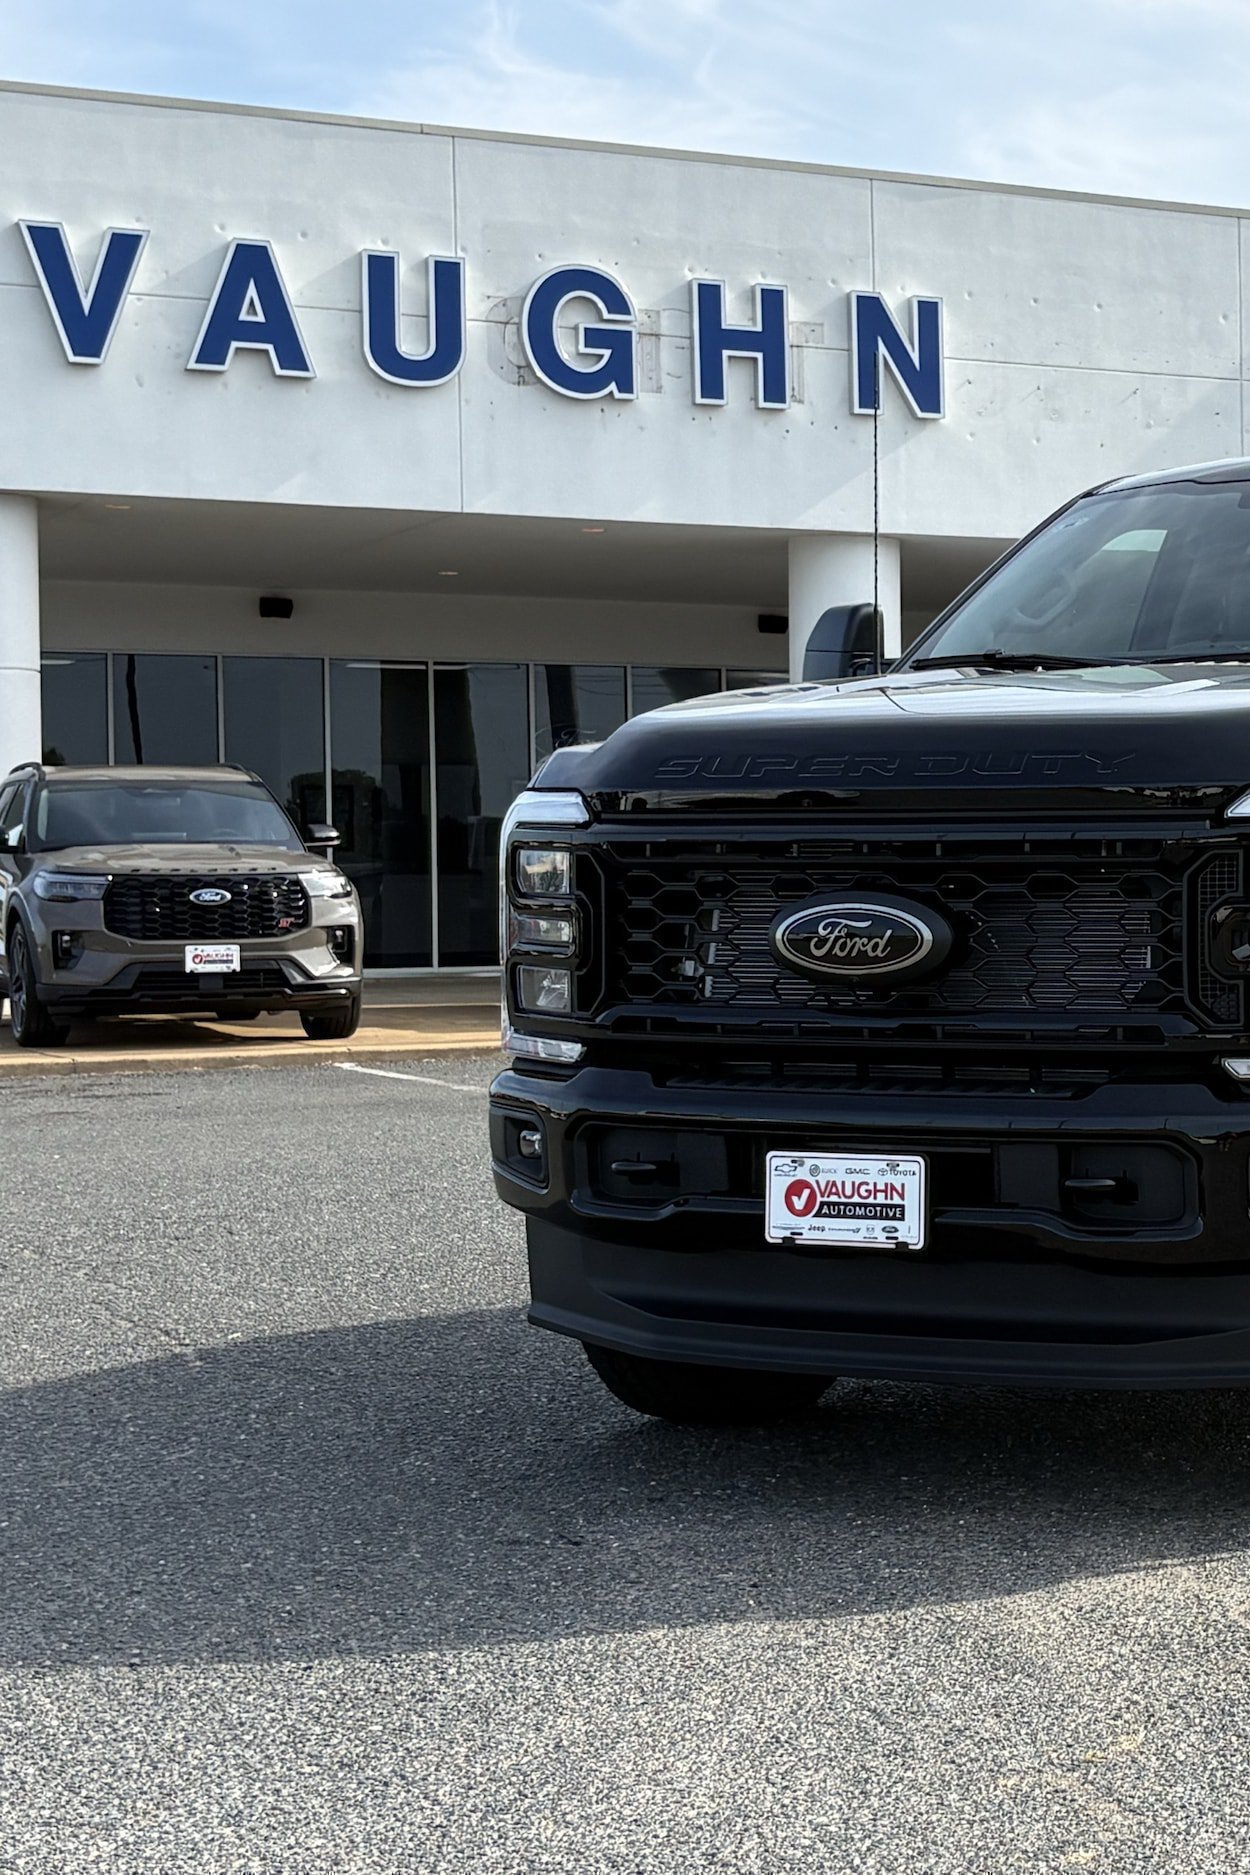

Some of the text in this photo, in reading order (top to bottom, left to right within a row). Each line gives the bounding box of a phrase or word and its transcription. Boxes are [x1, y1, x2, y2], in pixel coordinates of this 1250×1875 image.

[18, 218, 946, 420] VAUGHN
[655, 751, 1137, 779] SUPER DUTY
[810, 918, 893, 957] Ford
[845, 1167, 871, 1175] GMC
[889, 1168, 917, 1176] TOYOTA
[815, 1179, 906, 1201] VAUGHN
[821, 1203, 903, 1218] AUTOMOTIVE
[807, 1224, 826, 1233] Jeep
